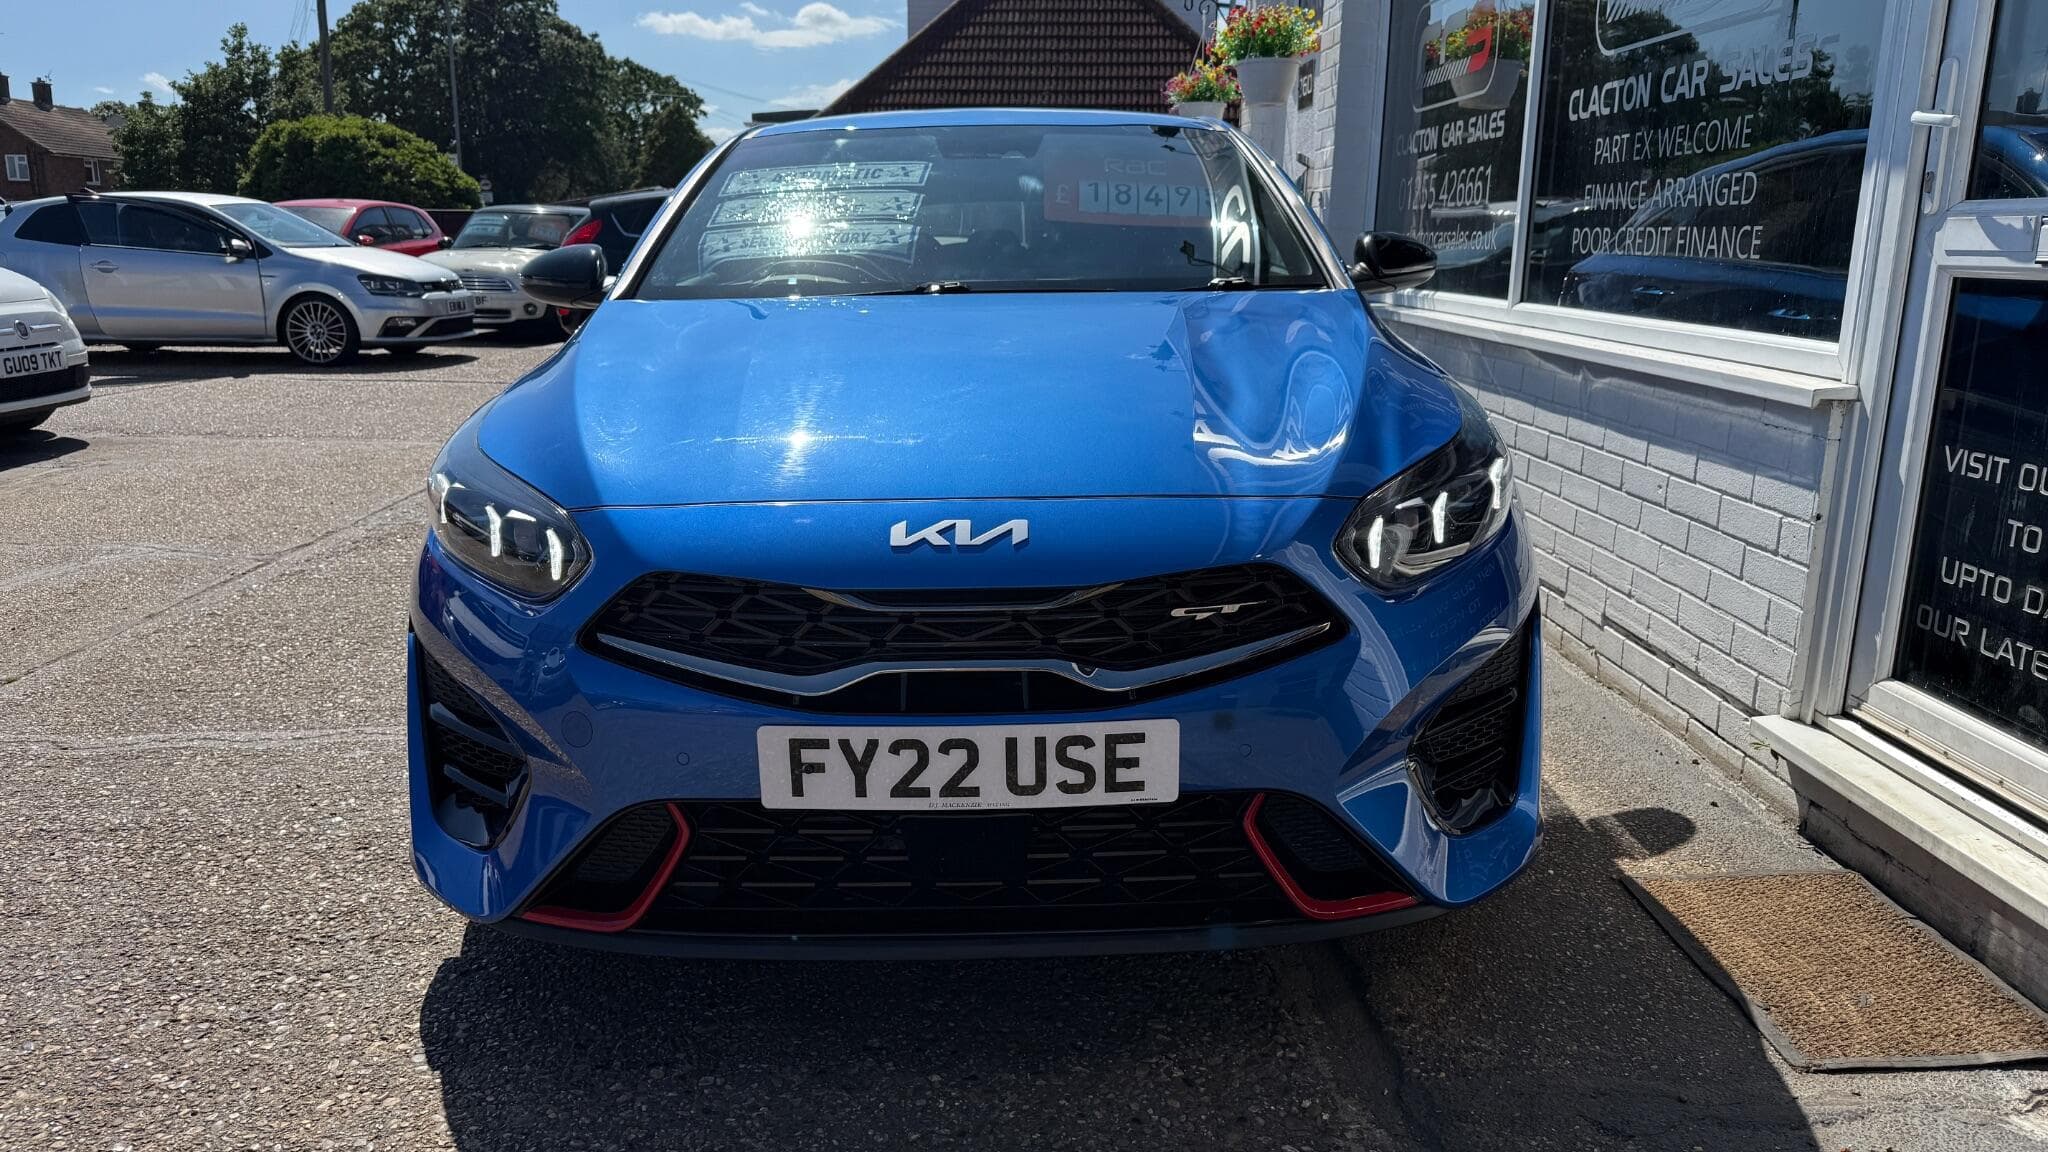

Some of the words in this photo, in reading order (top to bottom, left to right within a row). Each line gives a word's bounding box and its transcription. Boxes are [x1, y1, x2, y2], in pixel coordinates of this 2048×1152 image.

[1299, 74, 1312, 97] 60
[1568, 72, 1653, 122] CLACTON
[1660, 59, 1709, 104] CAR
[1719, 33, 1817, 94] SALES
[1397, 125, 1439, 156] CLACTON
[1441, 120, 1464, 149] CAR
[1467, 109, 1506, 144] SALES
[1594, 133, 1630, 166] PART
[1633, 129, 1654, 161] EX
[1658, 114, 1754, 158] WELCOME
[1438, 164, 1492, 207] 426661
[1583, 179, 1649, 211] FINANCE
[1650, 171, 1758, 209] ARRANGED
[1571, 227, 1611, 255] POOR
[1614, 226, 1672, 256] CREDIT
[1675, 225, 1763, 260] FINANCE
[4, 353, 39, 375] GU09
[40, 350, 62, 371] TKT
[1944, 444, 2010, 484] VISIT
[889, 519, 1029, 547] KIA
[2007, 518, 2043, 554] TO
[1940, 556, 2012, 604] UPTO
[1916, 603, 1970, 647] OUR
[788, 737, 981, 798] FY22
[1004, 732, 1146, 797] USE
